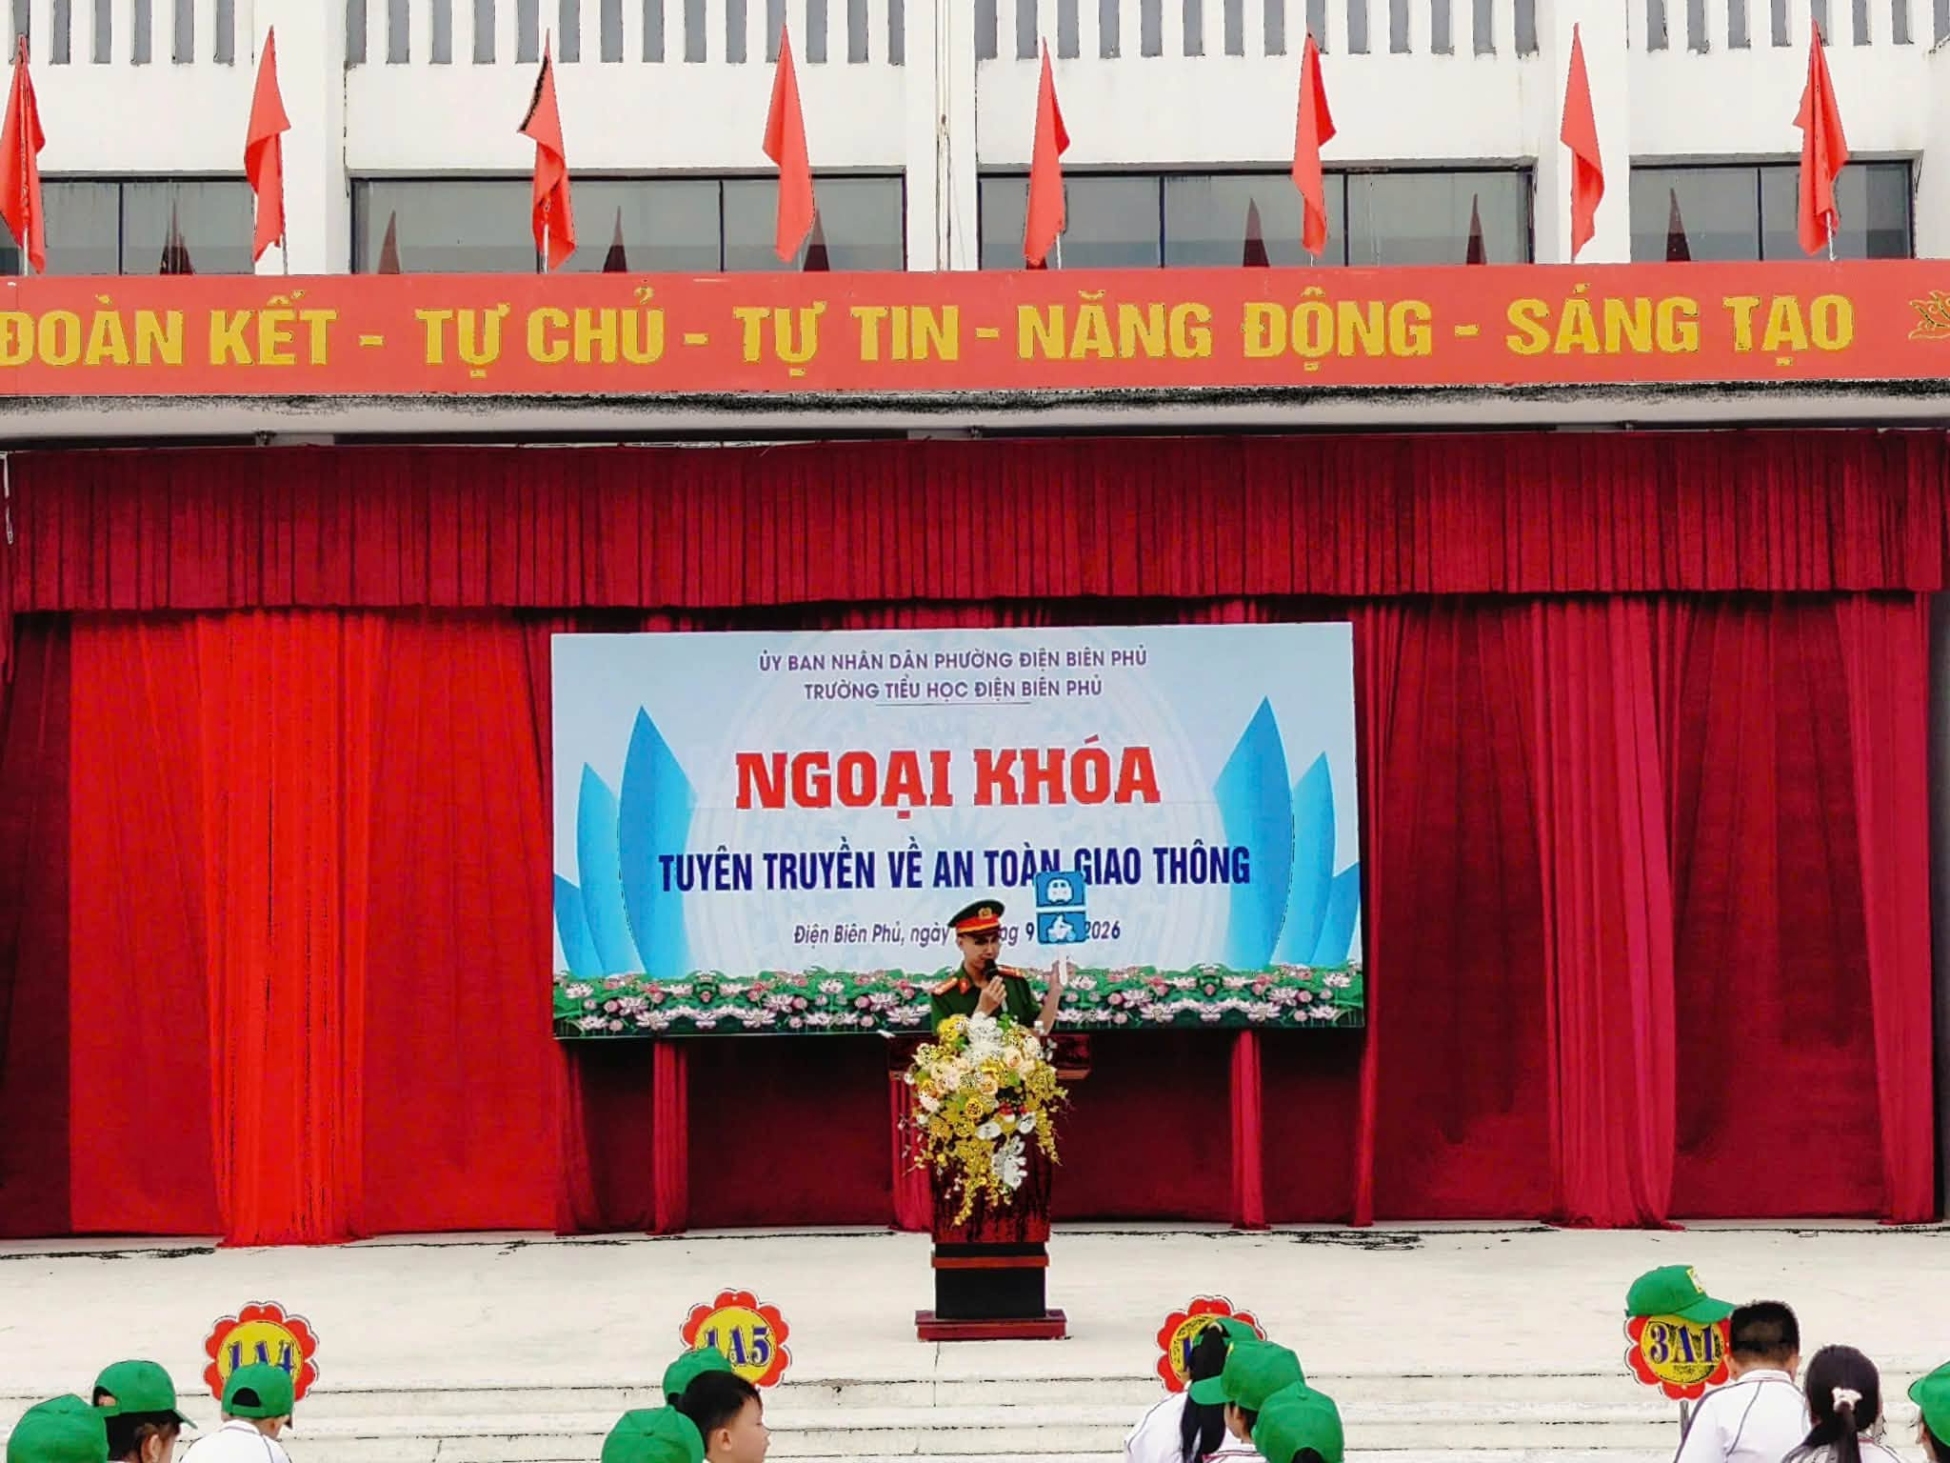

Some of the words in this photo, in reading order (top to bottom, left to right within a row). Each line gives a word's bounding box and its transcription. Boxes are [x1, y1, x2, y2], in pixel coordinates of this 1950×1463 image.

[0, 294, 184, 367] ĐOÀN
[208, 292, 338, 367] KẾT
[415, 302, 511, 378] TỰ
[526, 287, 666, 366] CHỦ
[733, 301, 827, 376] TỰ
[851, 305, 961, 362] TIN
[1017, 291, 1213, 361] NĂNG
[1241, 286, 1433, 371] ĐỘNG
[1505, 282, 1701, 356] SÁNG
[1722, 293, 1856, 367] TẠO
[759, 650, 782, 671] ỦY
[788, 655, 825, 670] BAN
[831, 650, 883, 669] NHÂN
[890, 650, 928, 669] DÂN
[935, 648, 1013, 668] PHƯỜNG
[1019, 647, 1060, 672] ĐIỆN
[1066, 647, 1105, 667] BIÊN
[1111, 644, 1147, 666] PHỦ
[804, 679, 879, 699] TRƯỜNG
[885, 673, 920, 698] TIỂU
[927, 681, 968, 702] HỌC
[975, 676, 1015, 701] ĐIỆN
[1021, 676, 1060, 697] BIÊN
[1067, 674, 1103, 696] PHỦ
[735, 750, 954, 819] NGOẠI
[973, 733, 1161, 806] KHÓA
[658, 845, 752, 891] TUYÊN
[763, 836, 875, 890] TRUYỀN
[888, 836, 922, 888] VỀ
[932, 850, 973, 888] AN
[984, 842, 1060, 887] TOÀN
[1074, 847, 1141, 886] GIAO
[1153, 839, 1250, 885] THÔNG
[794, 923, 829, 949] Điện
[834, 923, 867, 943] Biên
[872, 921, 905, 945] Phủ,
[910, 922, 950, 947] ngày
[1025, 922, 1035, 941] 9
[1649, 1322, 1718, 1364] 3A1
